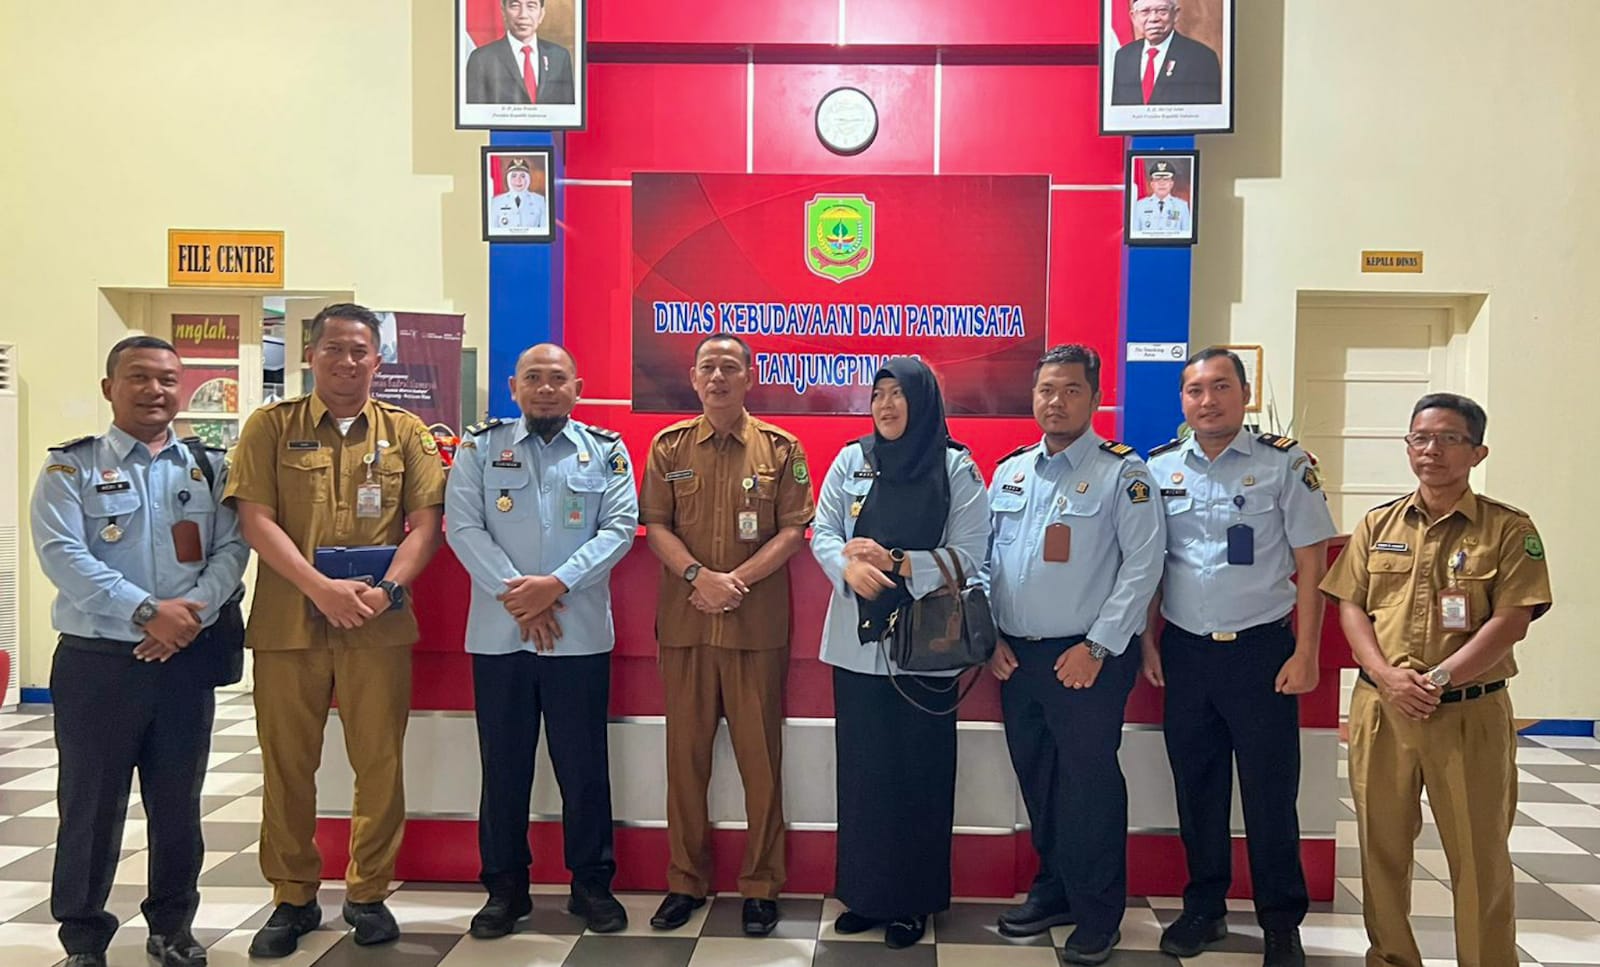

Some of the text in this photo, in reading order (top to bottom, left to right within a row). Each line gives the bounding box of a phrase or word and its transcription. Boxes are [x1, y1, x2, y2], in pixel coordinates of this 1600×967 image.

[178, 244, 275, 274] FILE CENTRE
[1366, 256, 1418, 268] KEPALA DINAS
[653, 301, 1025, 338] DINAS KEBUDAYAAN DAN PARIWISATA
[756, 353, 921, 395] TANJUNGPIN
